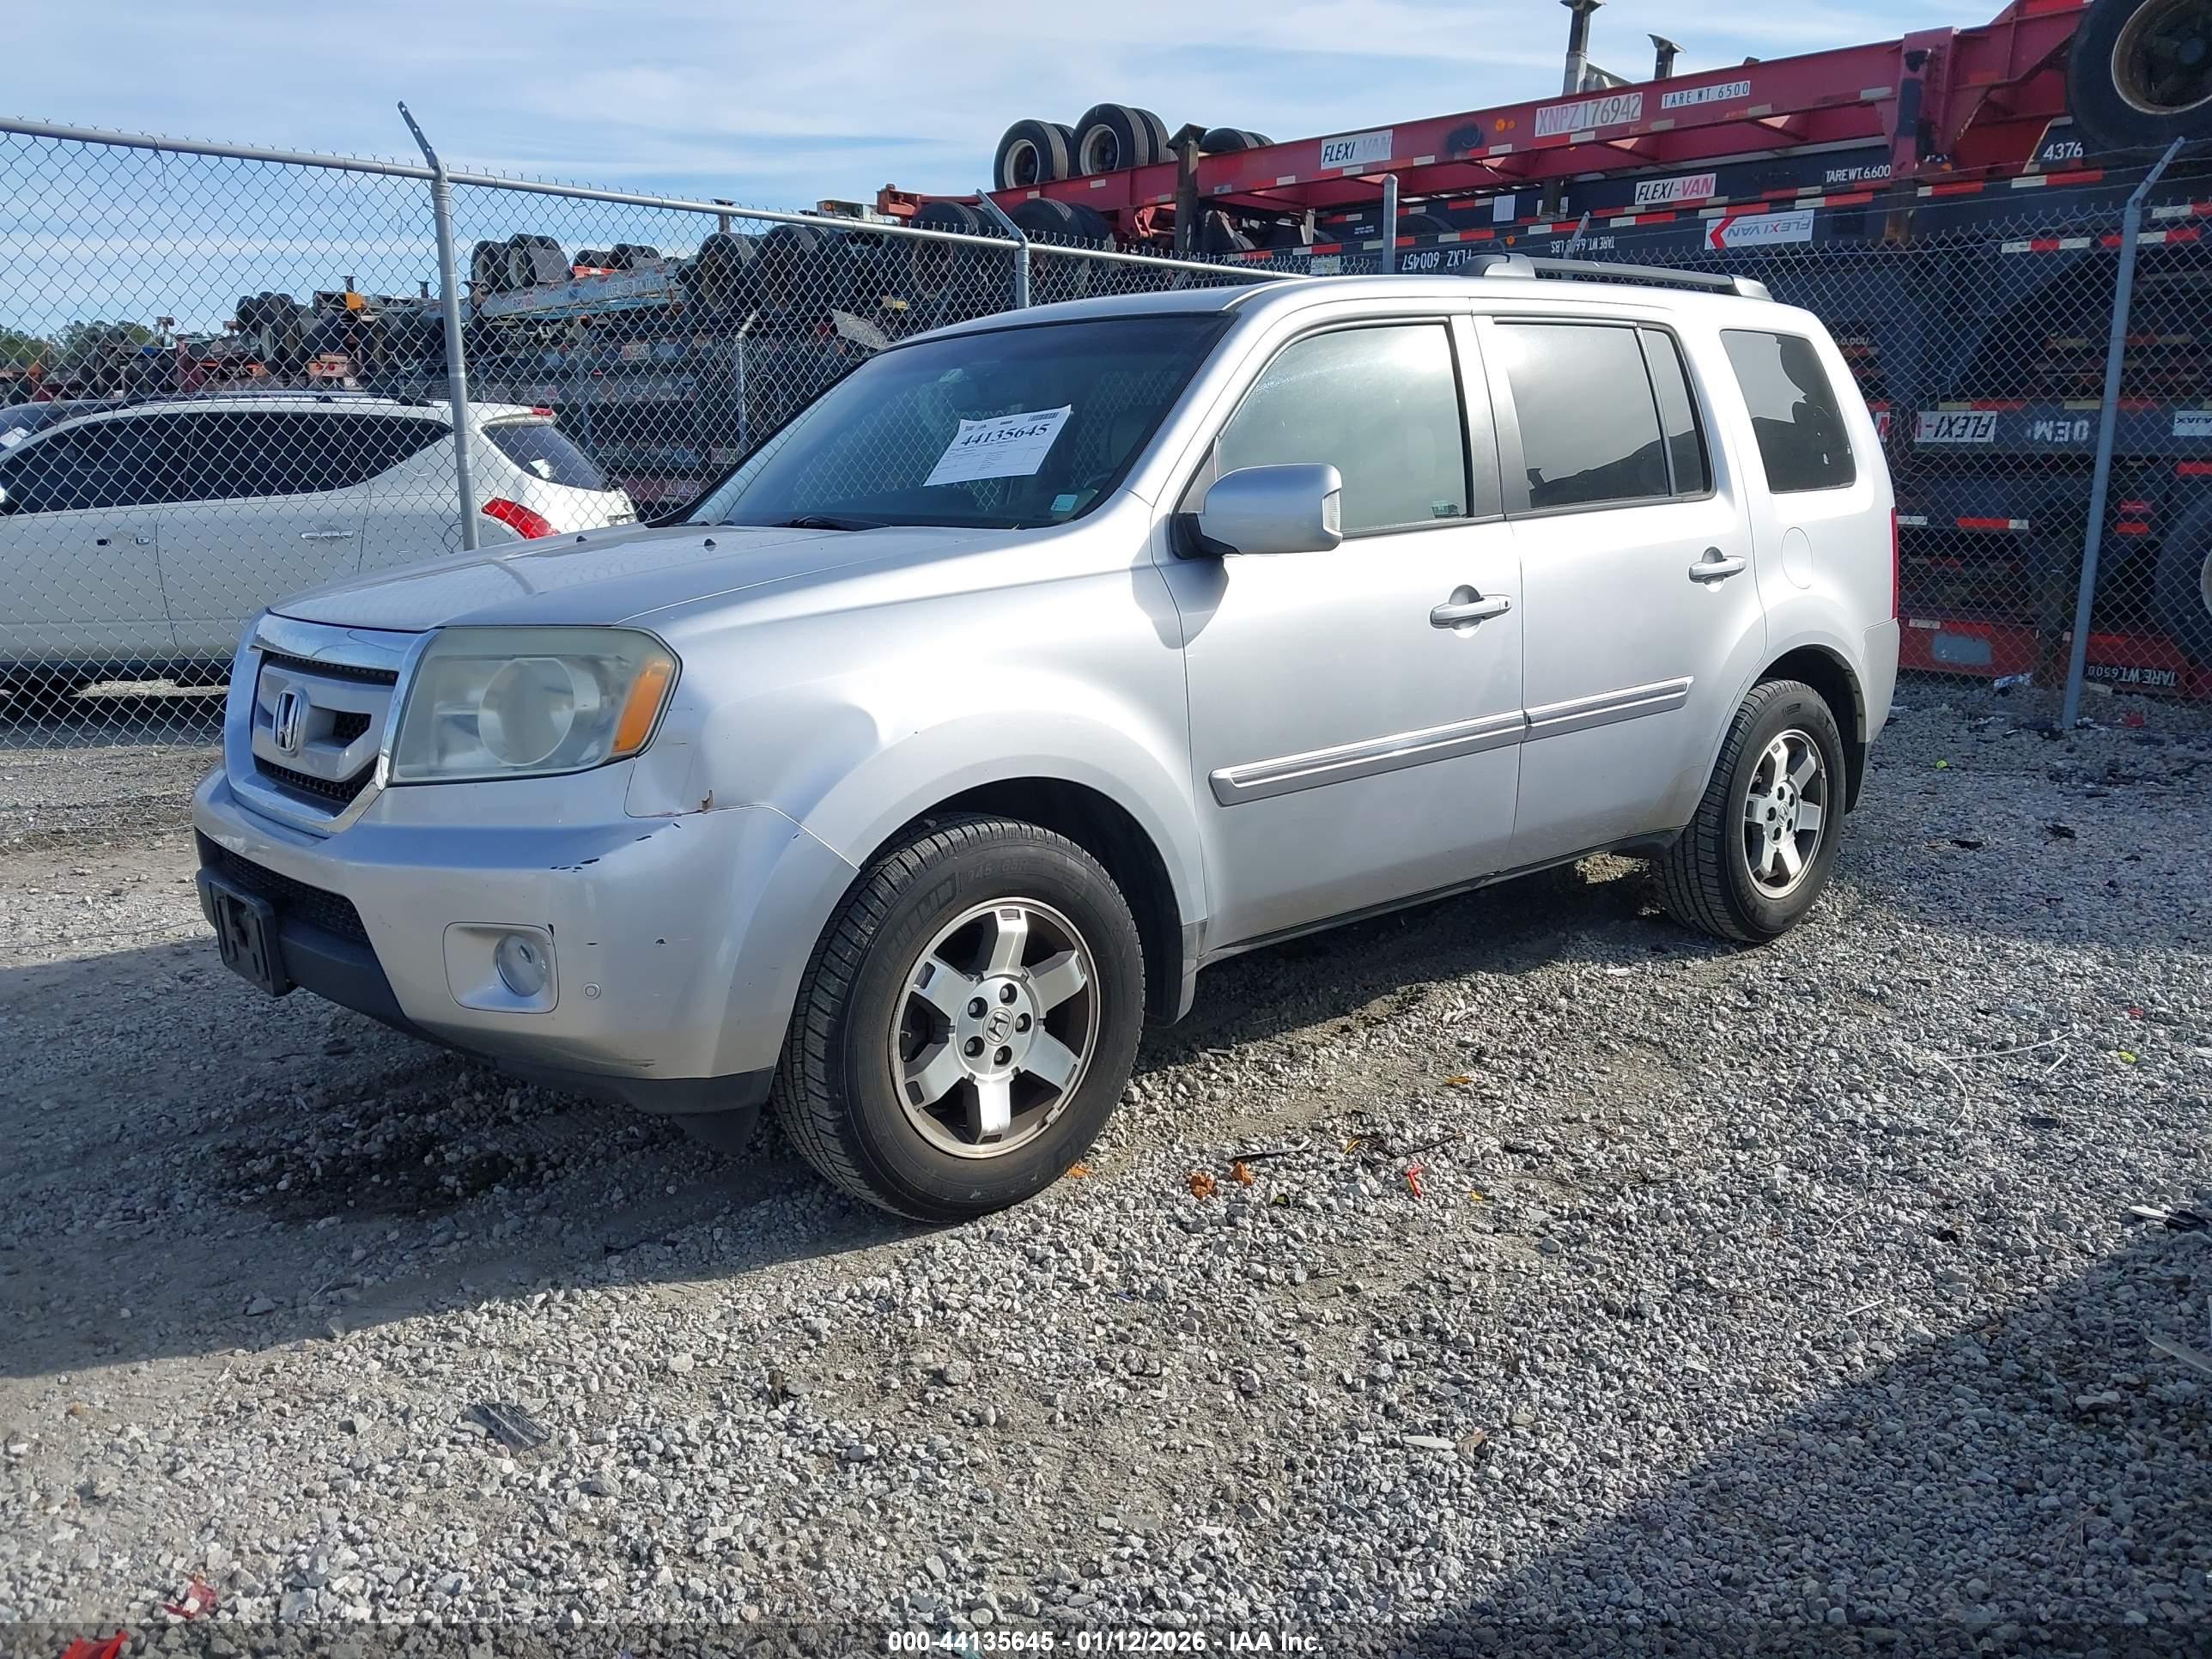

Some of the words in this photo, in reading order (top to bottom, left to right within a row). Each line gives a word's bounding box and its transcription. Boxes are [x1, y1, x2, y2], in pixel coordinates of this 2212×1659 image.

[1664, 91, 1692, 107] TARE
[1717, 82, 1749, 99] 6500
[2043, 142, 2083, 161] 4376
[1826, 170, 1847, 183] TARE
[1636, 178, 1715, 201] FLEXI-VAN
[1727, 224, 1760, 238] VAN
[1765, 219, 1812, 234] FLEXI
[1401, 251, 1440, 270] 600457
[961, 423, 1050, 447] 44135645
[2142, 669, 2177, 687] TARE
